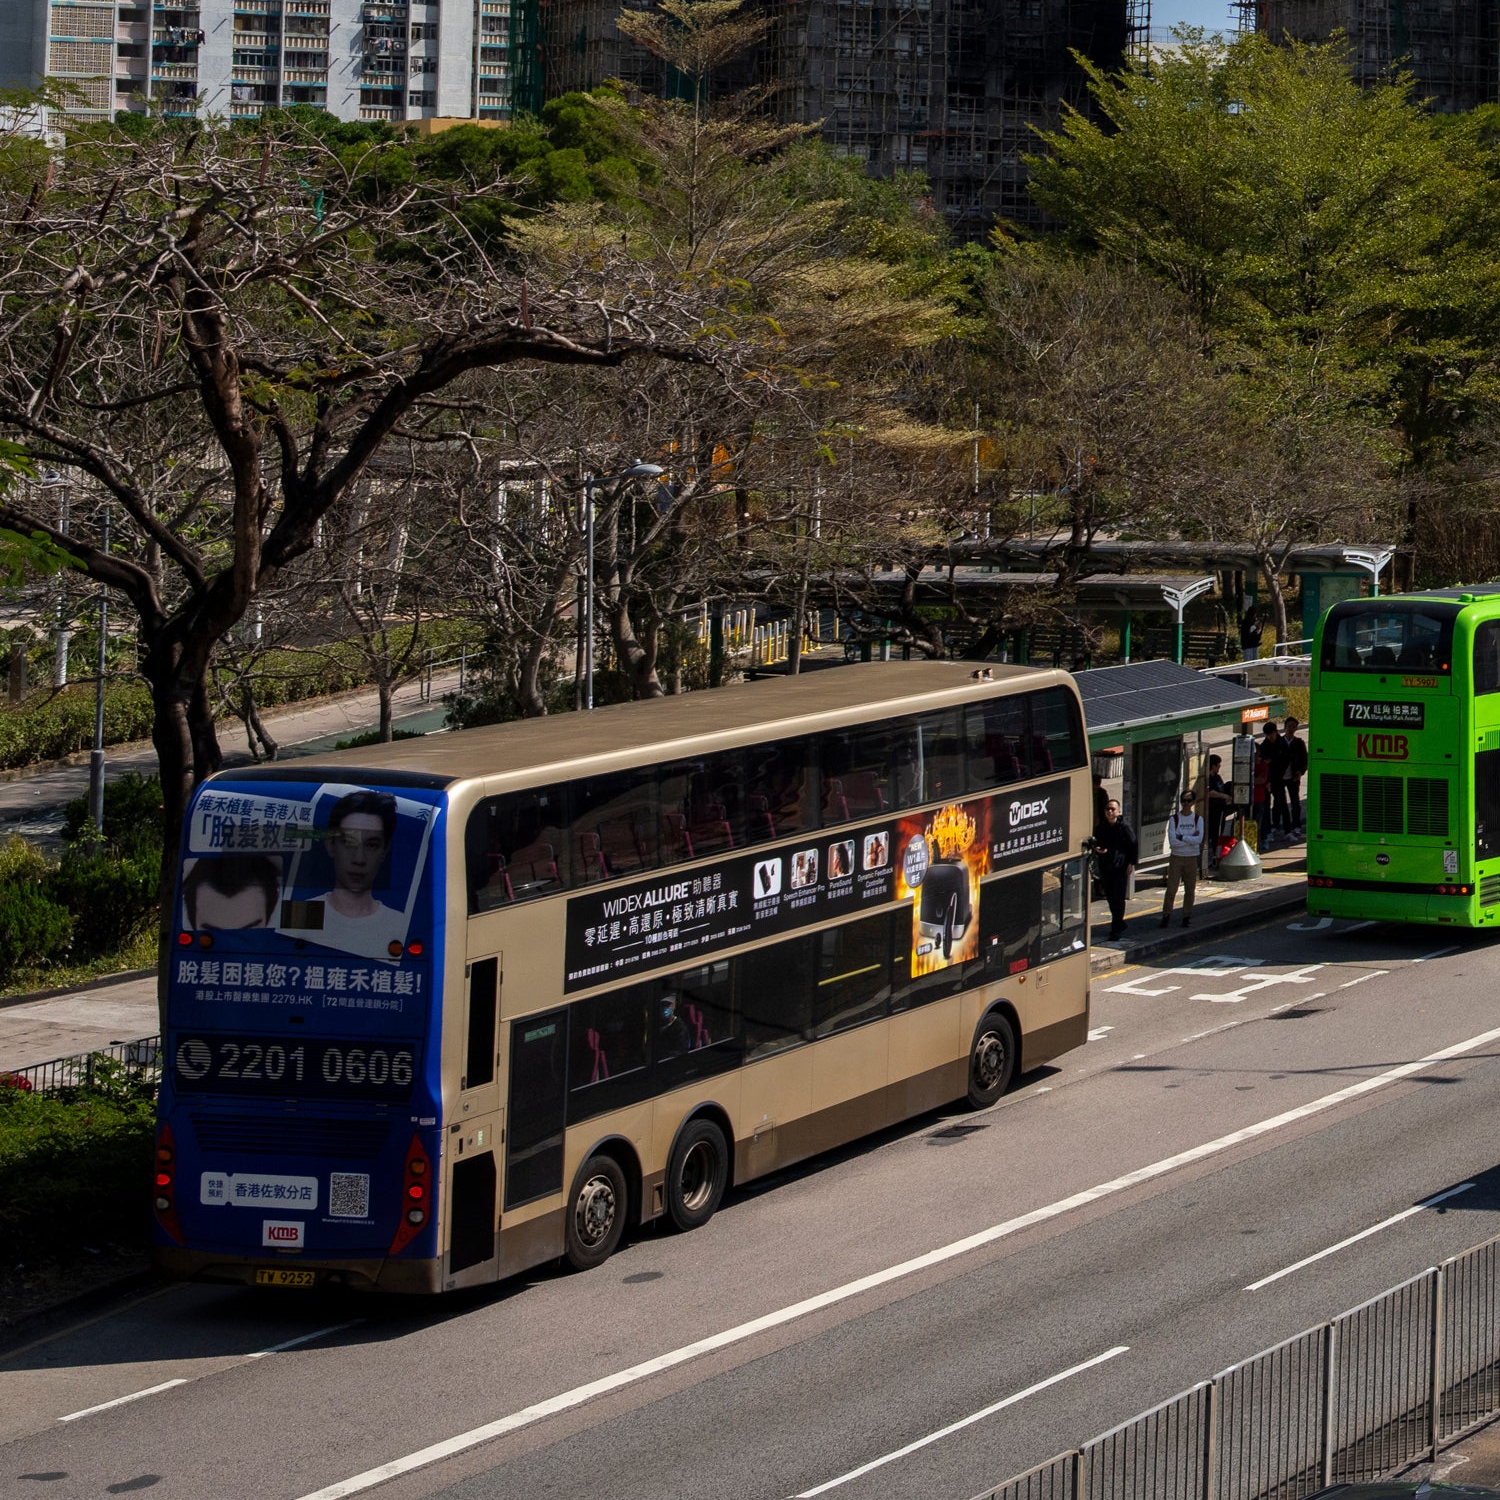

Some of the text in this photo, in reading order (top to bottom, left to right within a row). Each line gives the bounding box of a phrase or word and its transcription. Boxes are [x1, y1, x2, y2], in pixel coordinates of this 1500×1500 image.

[1348, 704, 1371, 719] 72X
[1356, 732, 1410, 761] KMB
[1008, 797, 1051, 827] WIDEX
[603, 893, 643, 919] WIDEX
[218, 1043, 413, 1086] 2201 0606
[234, 1182, 313, 1201] 香港佐敦分店
[268, 1226, 299, 1241] KMB
[259, 1270, 314, 1285] TW 9252
